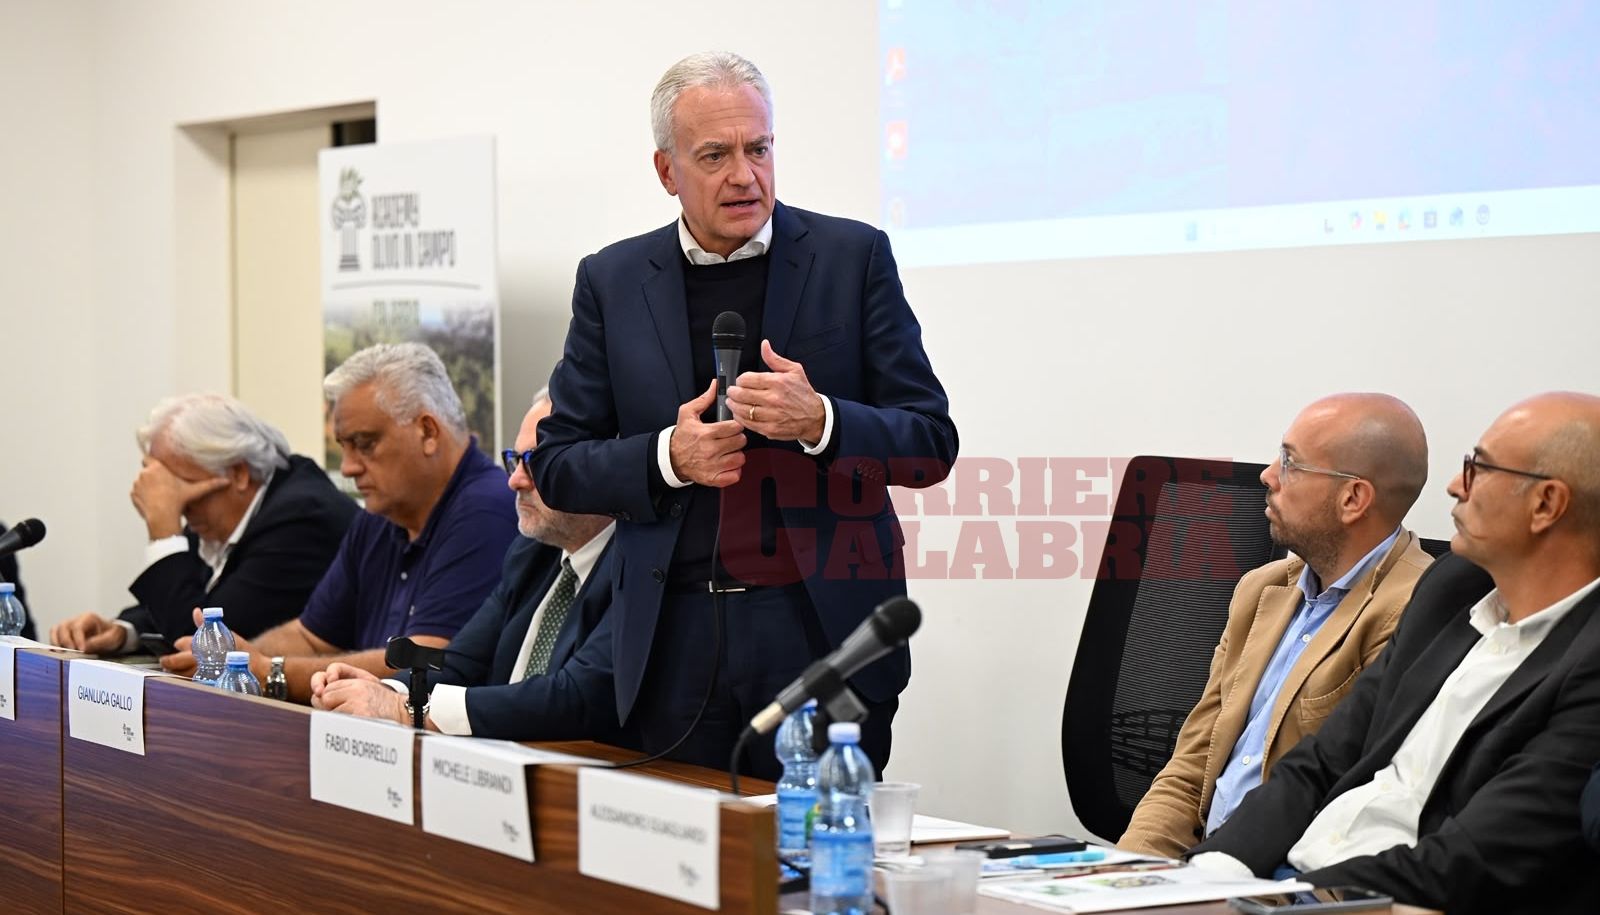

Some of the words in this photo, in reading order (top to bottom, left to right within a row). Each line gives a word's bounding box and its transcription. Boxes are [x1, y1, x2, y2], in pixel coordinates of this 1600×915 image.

[77, 685, 110, 706] GIANLUCA
[111, 692, 133, 712] GALLO
[325, 732, 350, 755] FABIO
[352, 738, 398, 766] BORRELLO
[433, 757, 470, 785] MICHELE
